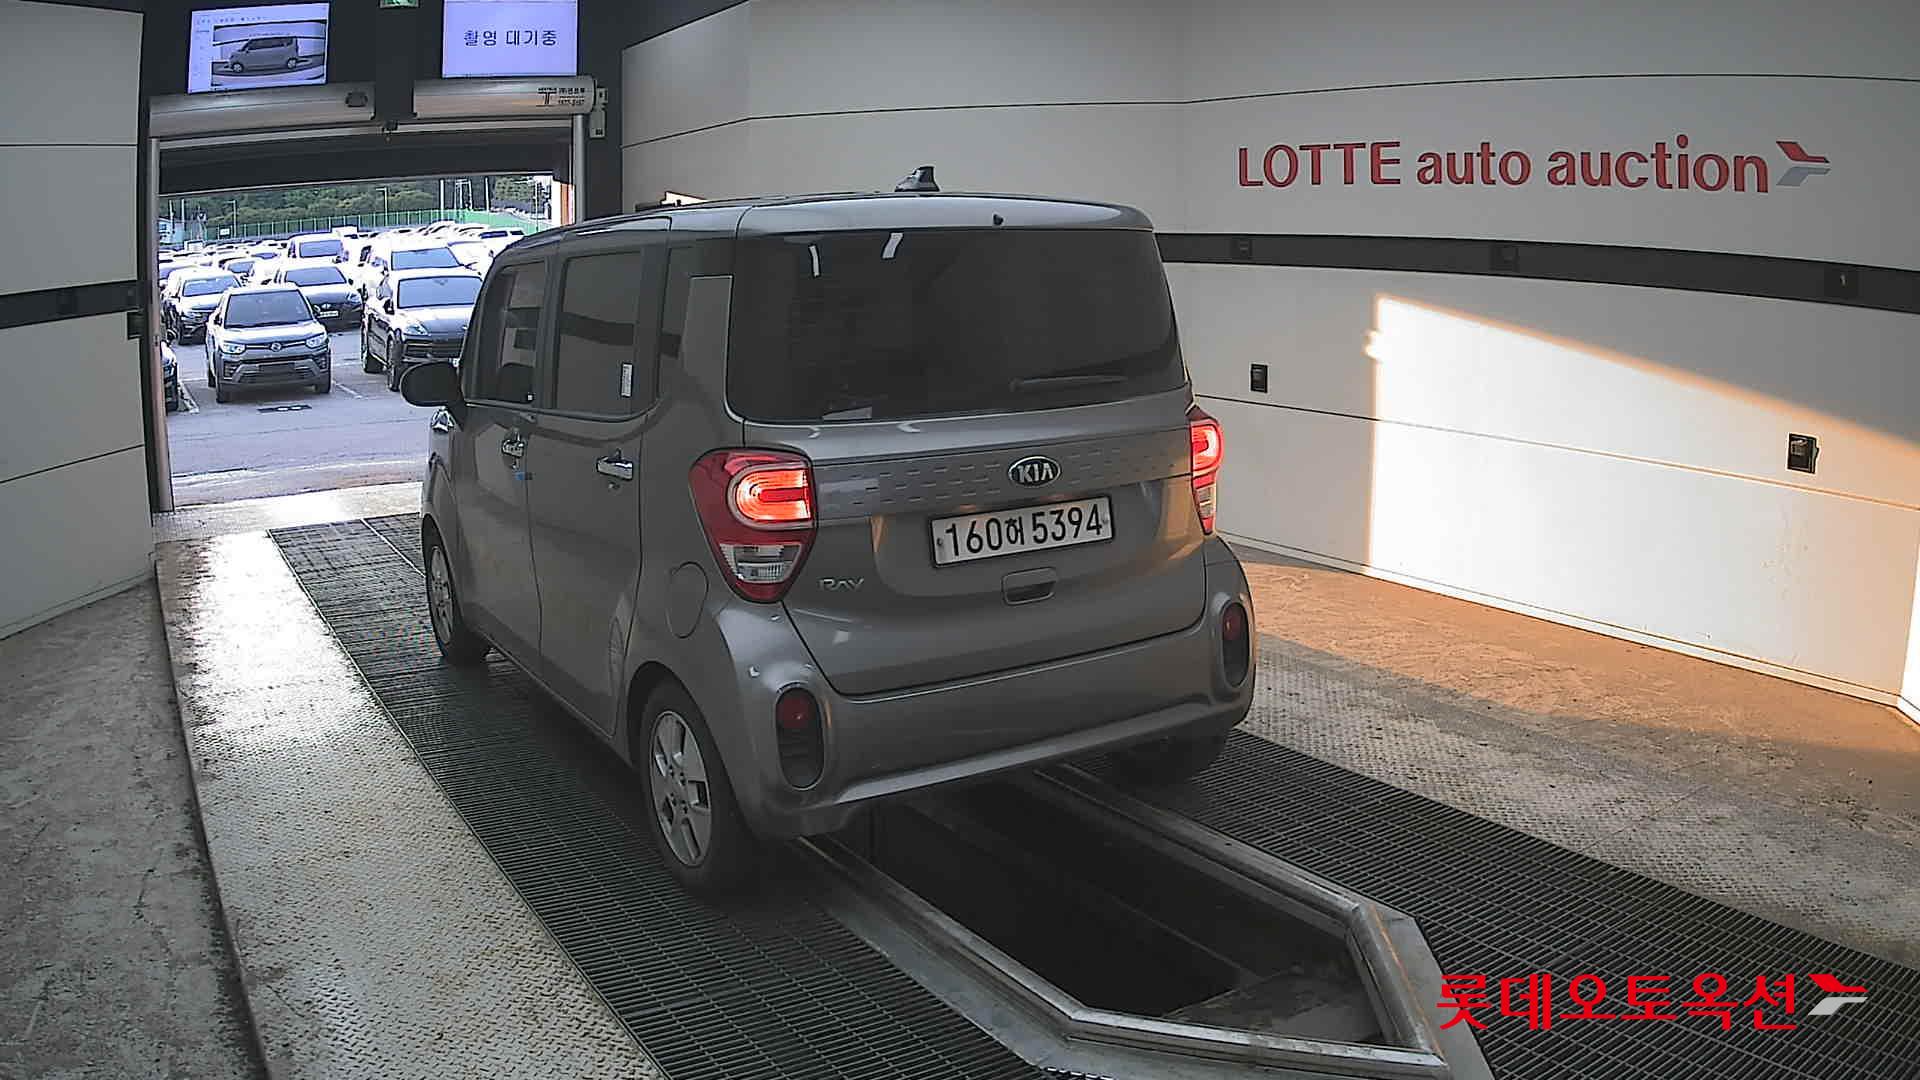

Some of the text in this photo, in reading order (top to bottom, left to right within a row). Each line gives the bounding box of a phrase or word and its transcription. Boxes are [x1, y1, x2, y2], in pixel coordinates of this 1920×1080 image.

[464, 29, 557, 47] 촬영 대기중
[1238, 134, 1769, 194] LOTTE auto auction
[1016, 462, 1054, 483] KIA
[945, 503, 1104, 557] 160허 5394
[818, 577, 866, 592] RAY
